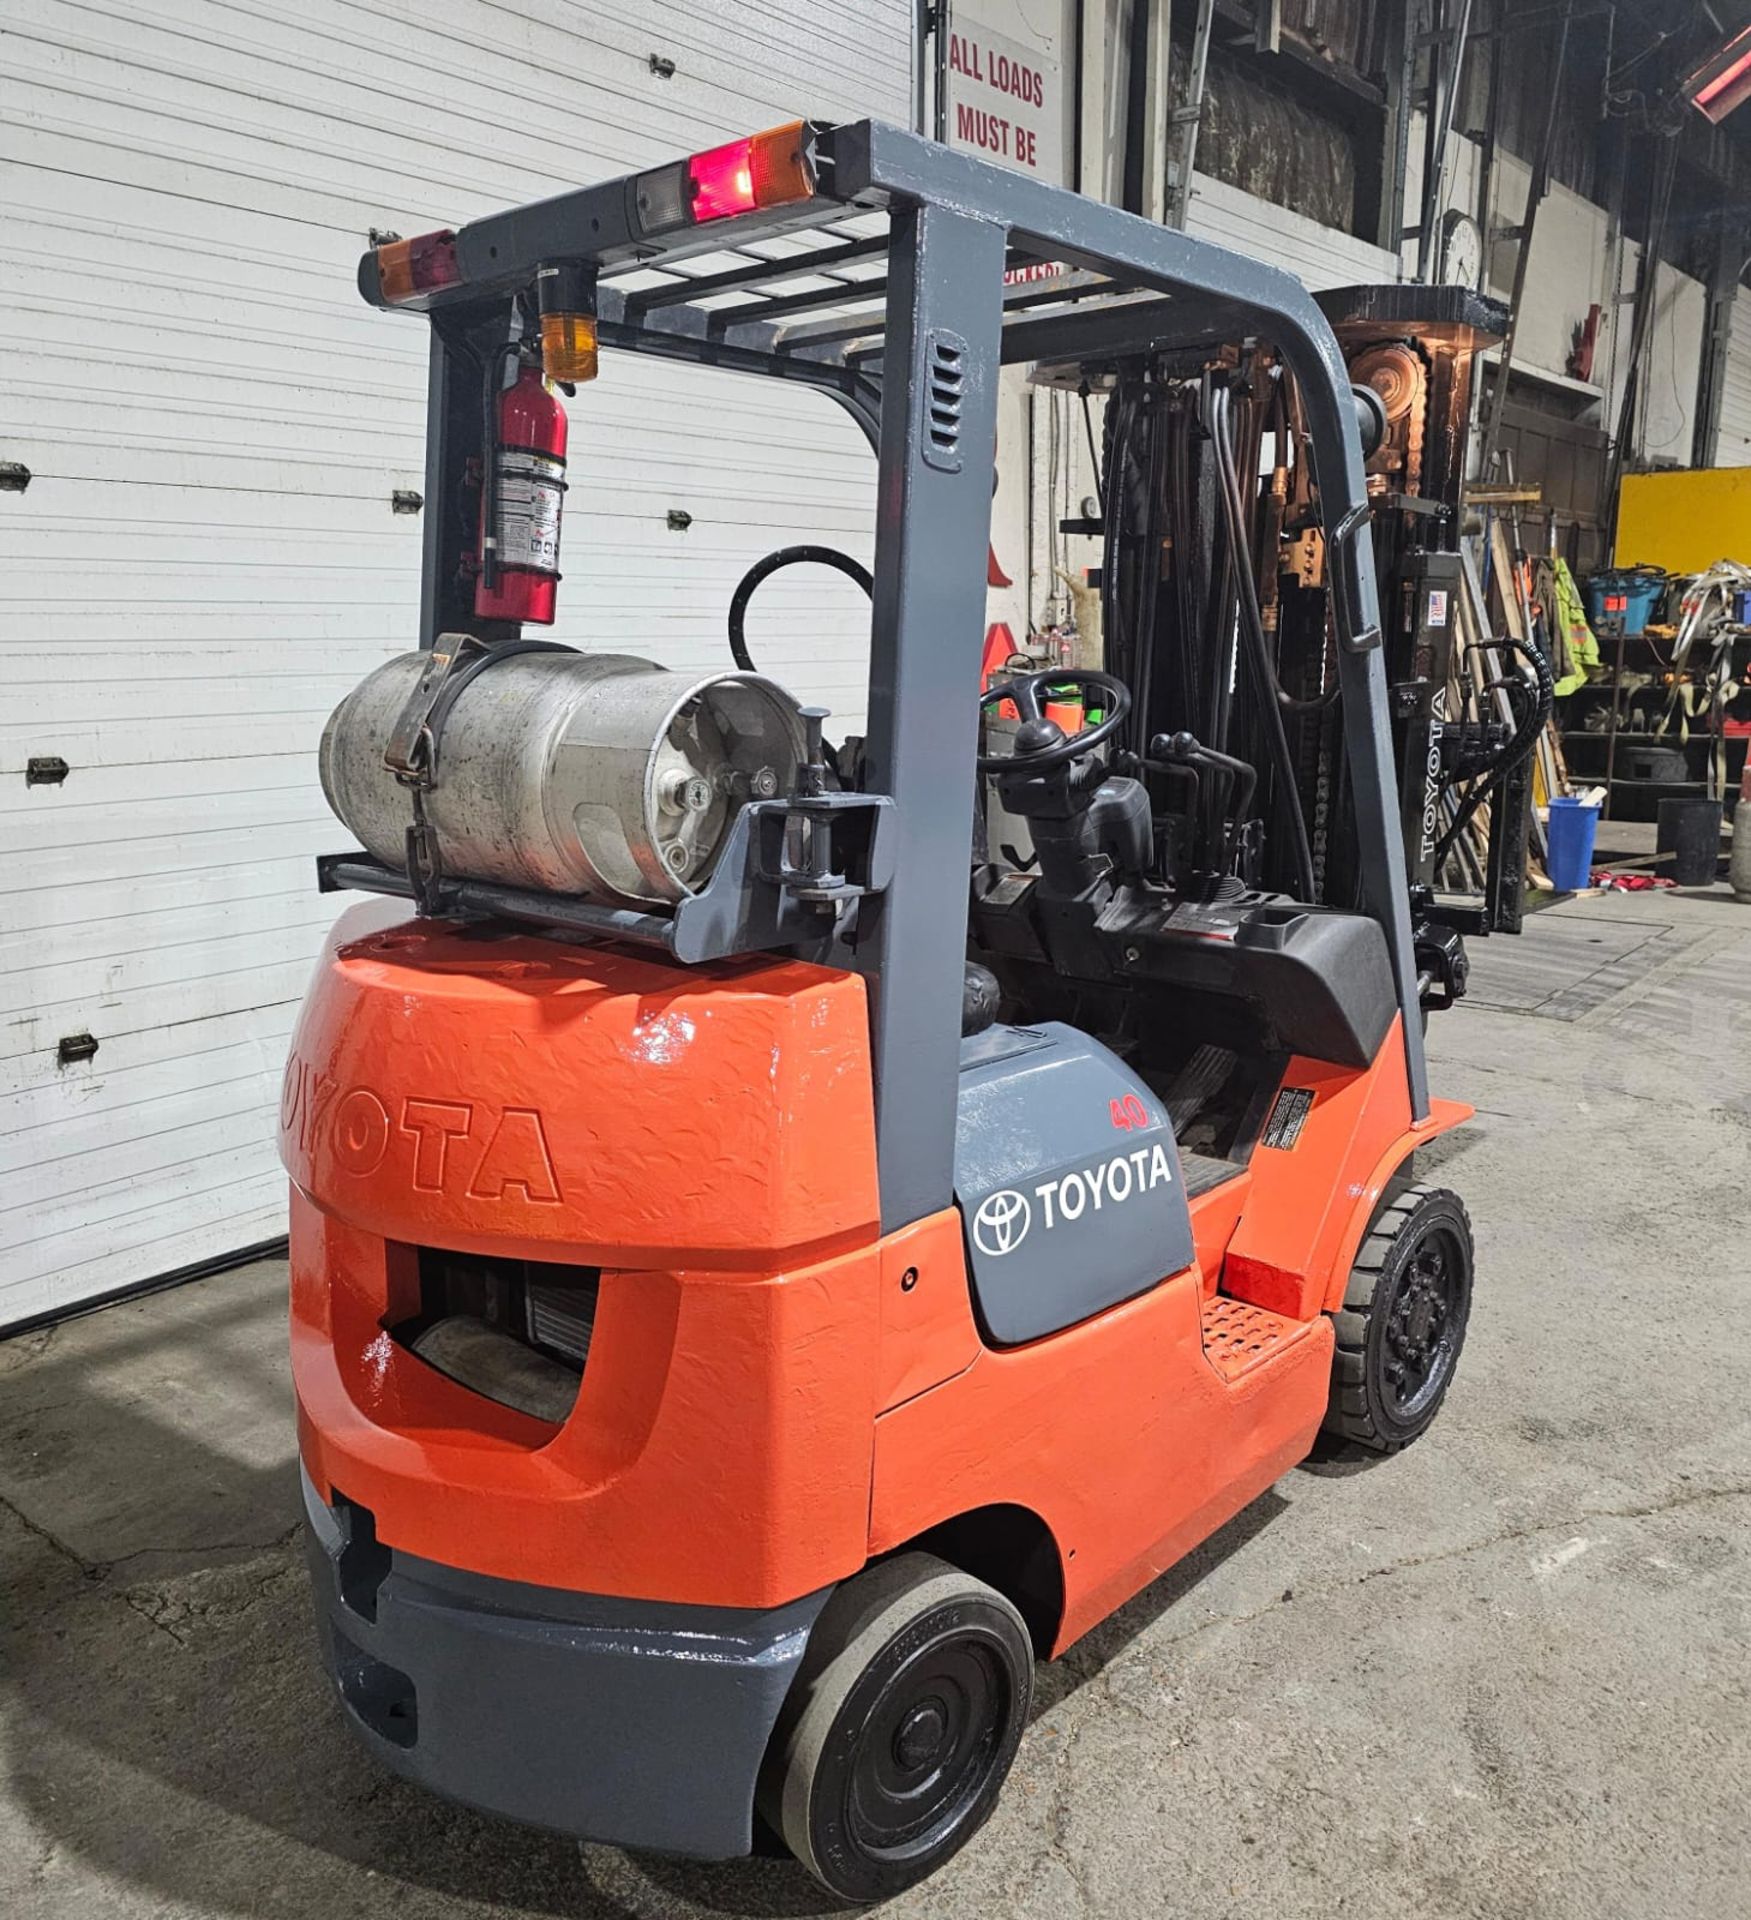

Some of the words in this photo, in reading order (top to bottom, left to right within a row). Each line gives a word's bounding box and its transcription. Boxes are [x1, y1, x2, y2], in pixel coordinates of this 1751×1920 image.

[950, 33, 983, 82] ALL
[989, 51, 1043, 108] LOADS
[957, 103, 1010, 155] MUST
[1016, 125, 1037, 167] BE
[1420, 687, 1446, 862] TOYOTA
[1109, 1093, 1149, 1132] 40
[1035, 1144, 1172, 1228] TOYOTA
